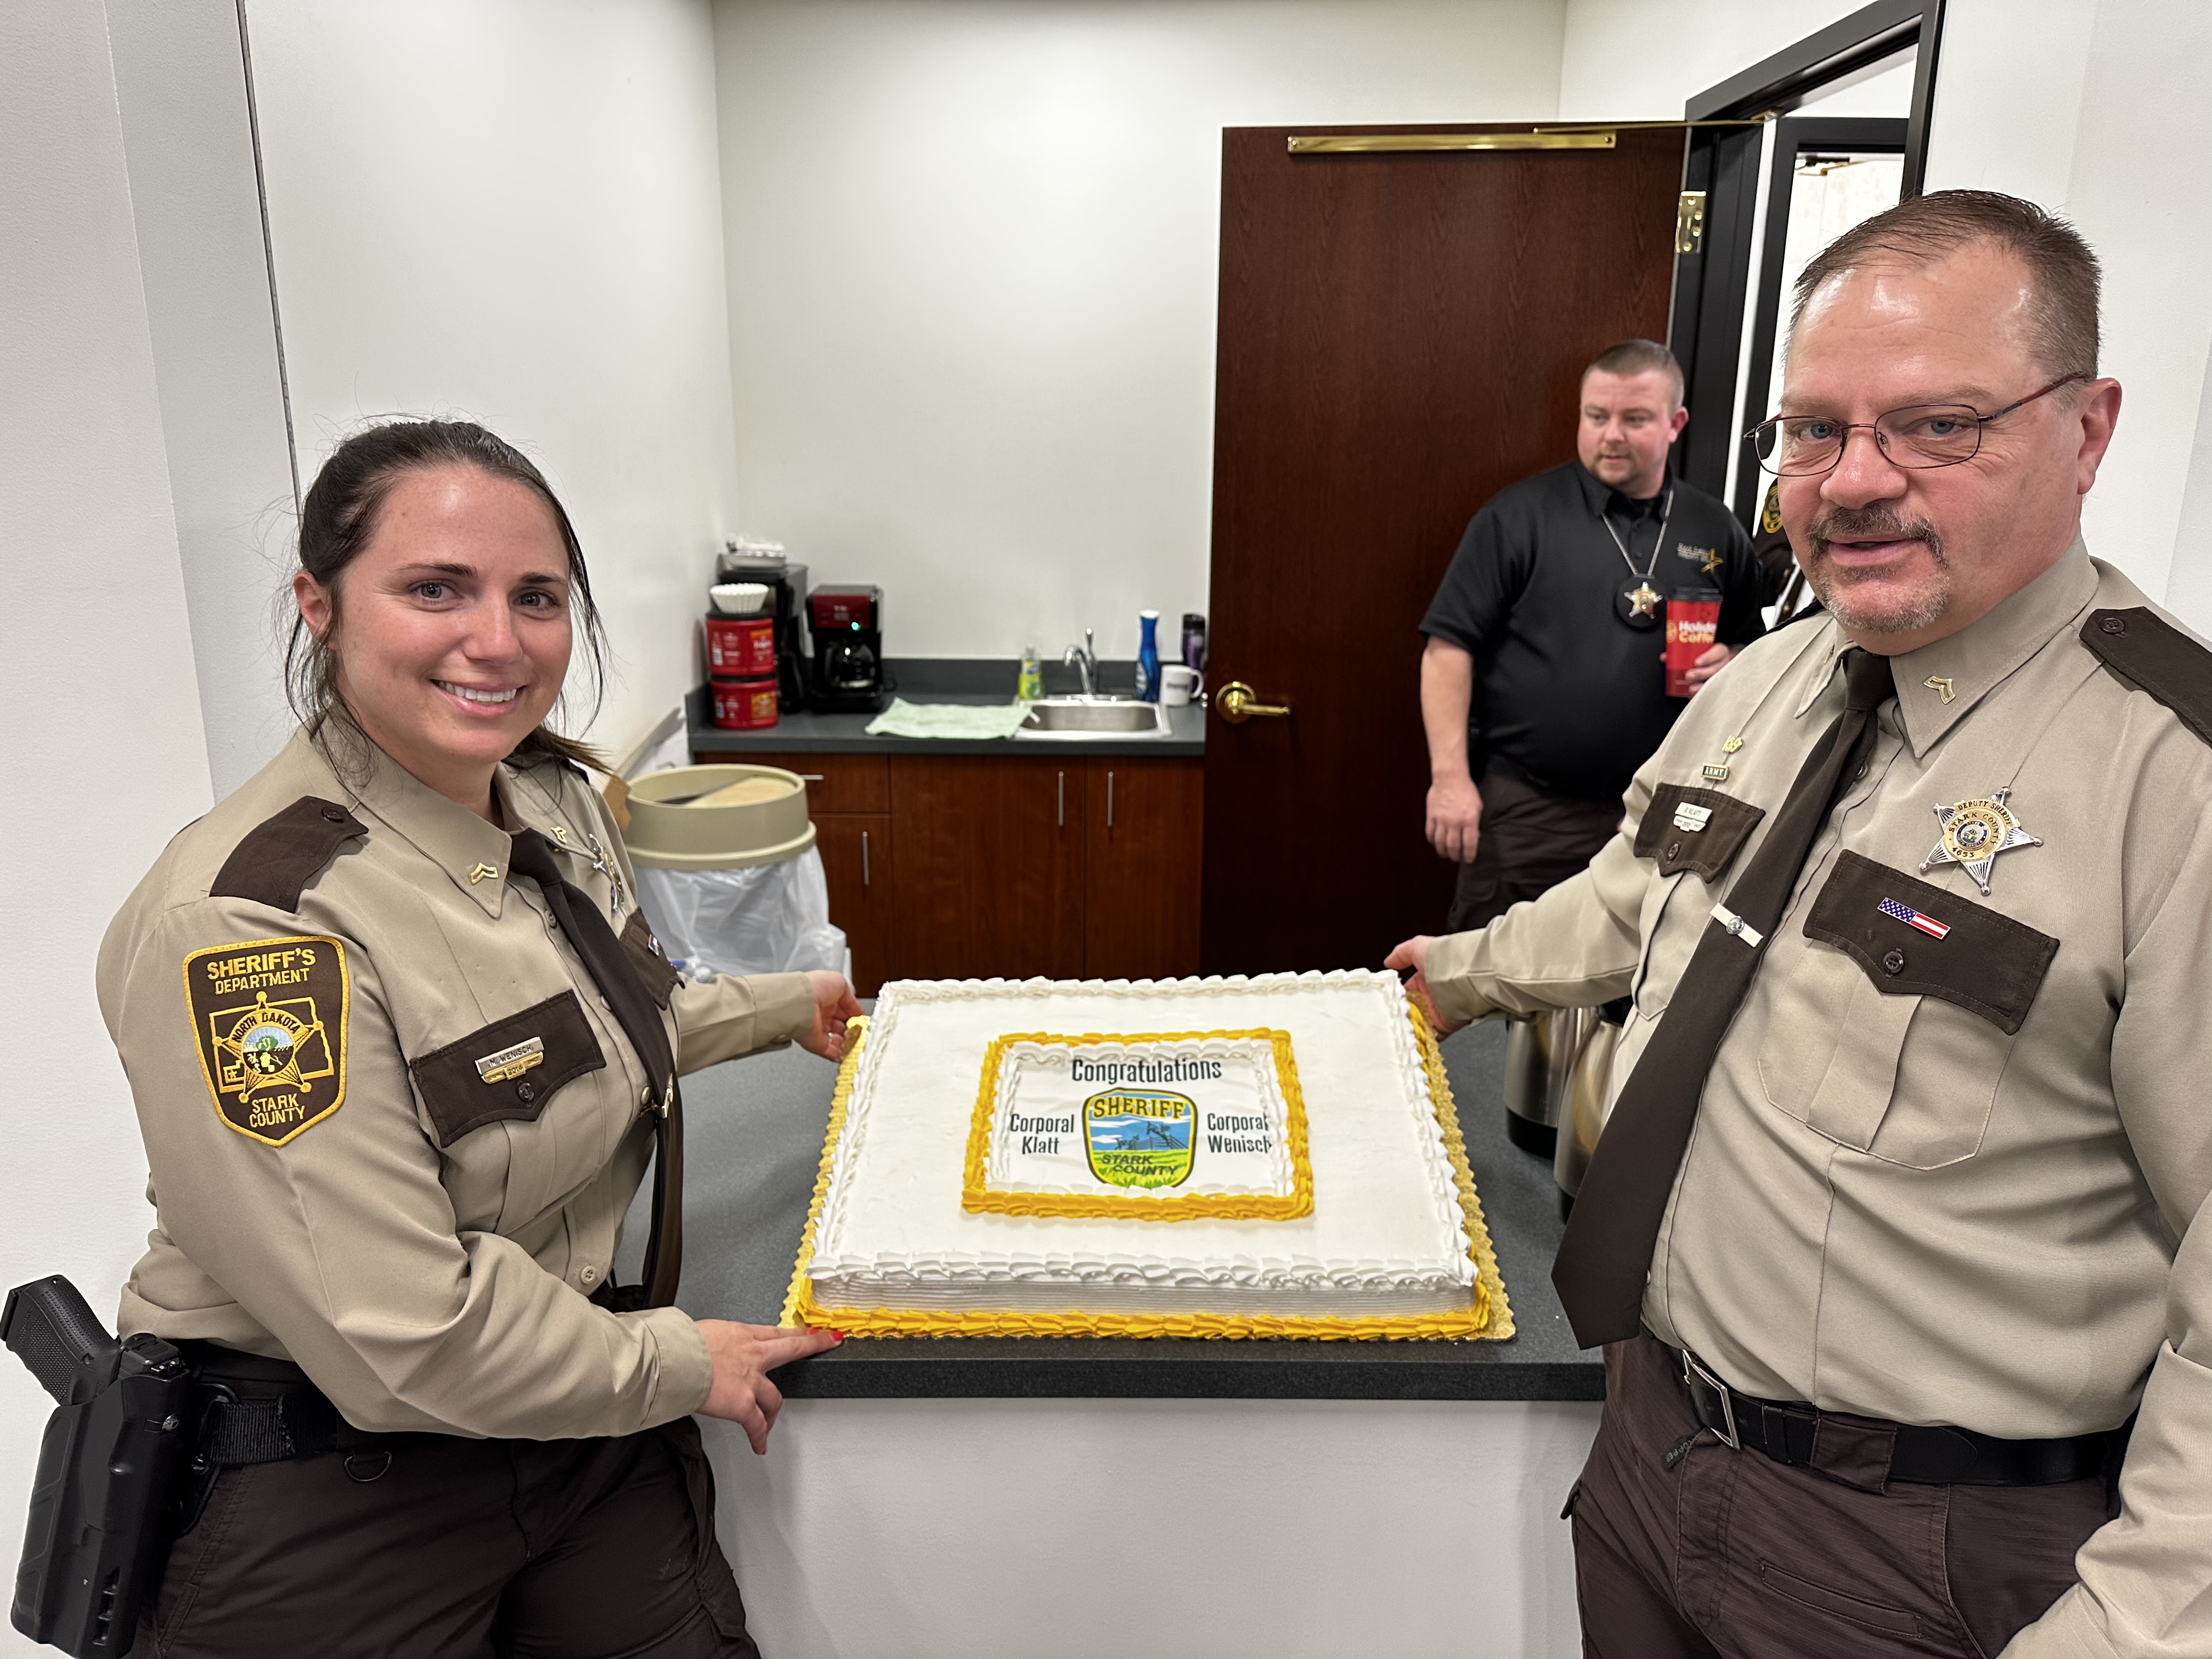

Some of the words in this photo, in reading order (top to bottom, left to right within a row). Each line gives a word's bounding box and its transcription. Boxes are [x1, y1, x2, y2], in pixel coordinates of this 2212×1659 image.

[1704, 766, 1724, 776] ARMY
[1958, 800, 1989, 811] DEPUTY
[1990, 803, 2012, 825] SHERIFF
[1949, 812, 1978, 832] STARK
[1983, 814, 1999, 845] COUNTY
[1952, 847, 1975, 857] 4653
[207, 947, 316, 980] SHERIFF'S
[215, 967, 310, 995] DEPARTMENT
[232, 1015, 258, 1043] NORTH
[262, 1012, 301, 1034] DAKOTA
[499, 1044, 532, 1063] WENISCH
[508, 1065, 523, 1076] 2014
[1071, 1058, 1222, 1085] Congratulations
[251, 1092, 299, 1114] STARK
[1093, 1096, 1184, 1119] SHERIFF
[249, 1105, 306, 1128] COUNTY
[1010, 1113, 1075, 1135] Corporal
[1207, 1112, 1269, 1133] Corporal
[1022, 1136, 1059, 1155] Klatt
[1207, 1135, 1272, 1154] Wenisch
[1102, 1154, 1153, 1165] STARK
[1113, 1164, 1178, 1175] COUNTY
